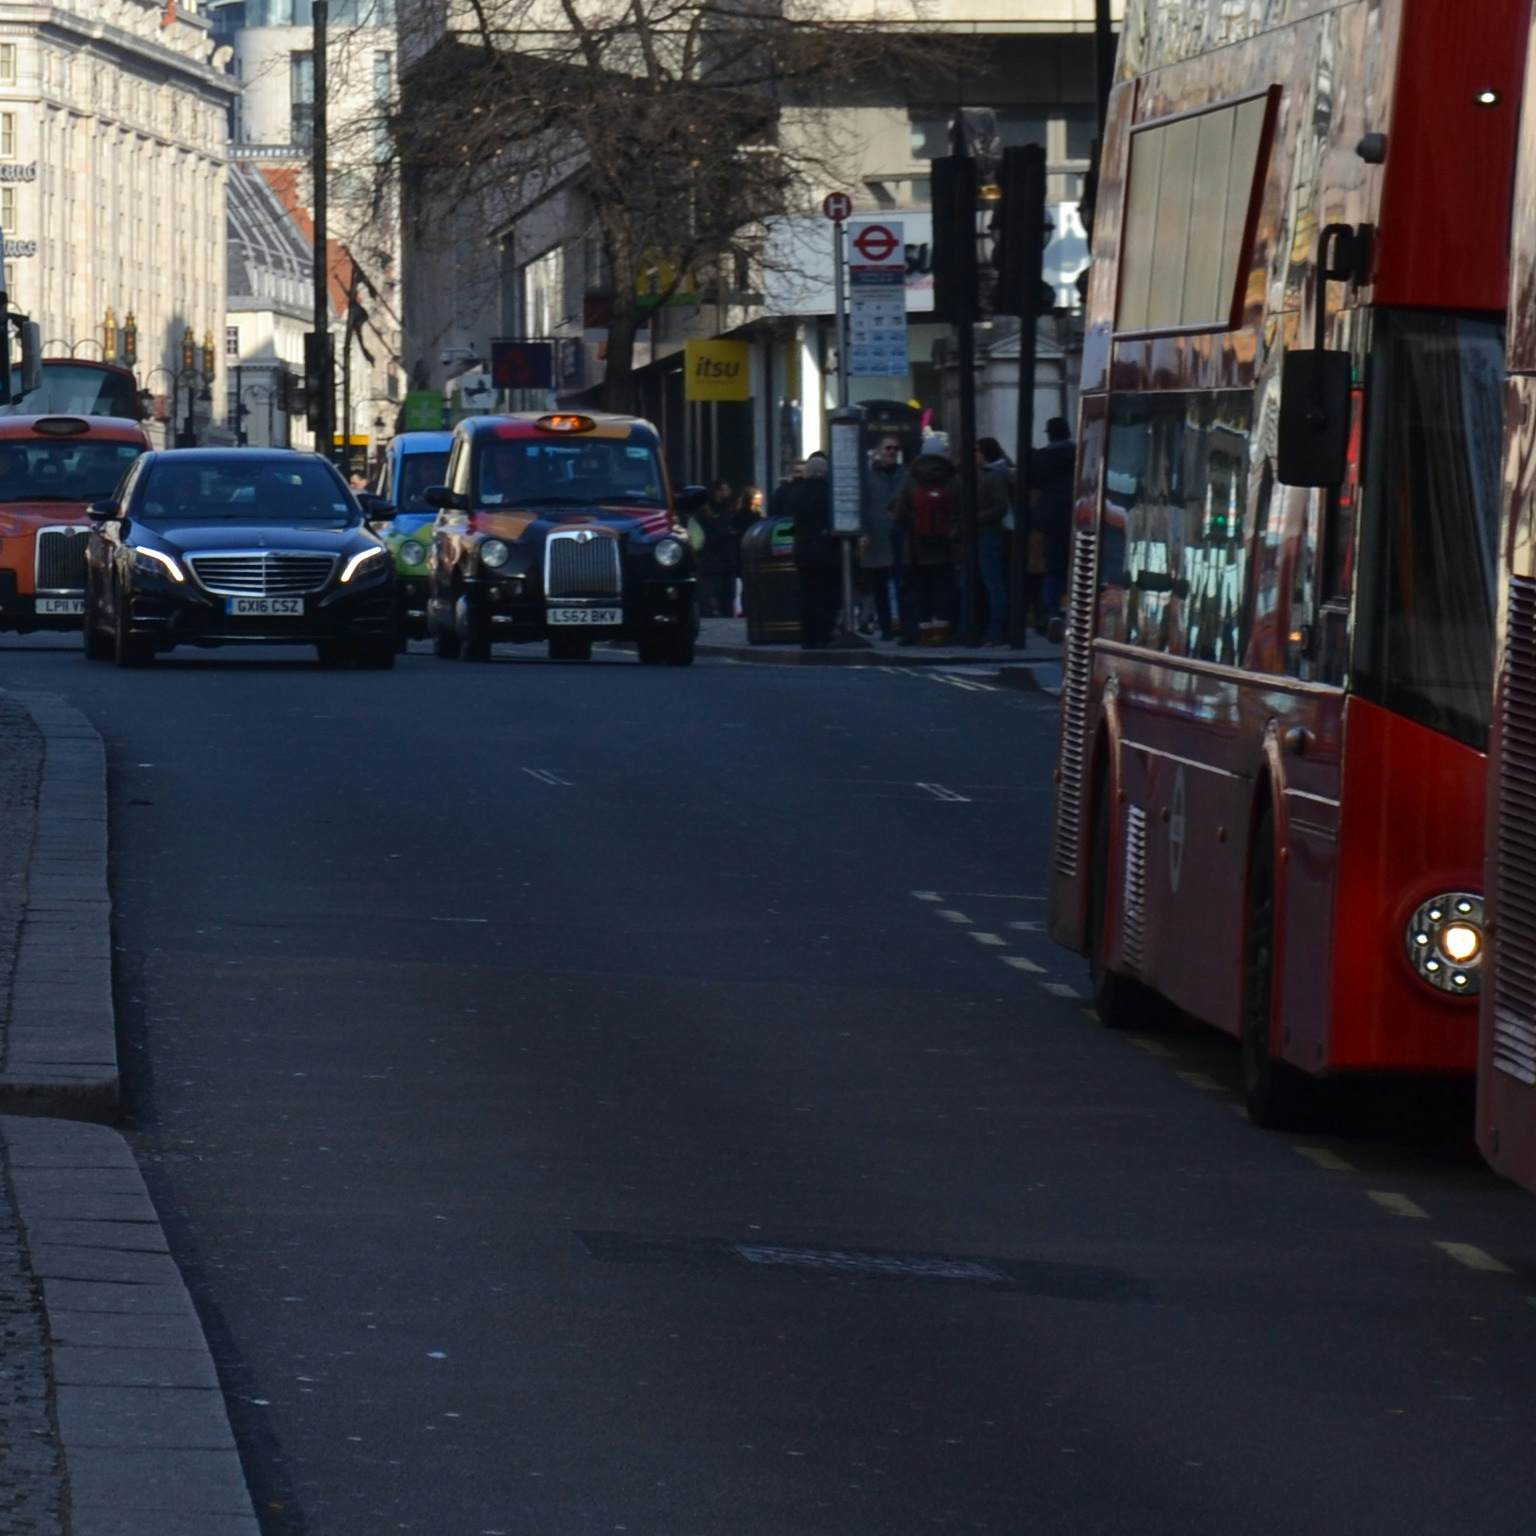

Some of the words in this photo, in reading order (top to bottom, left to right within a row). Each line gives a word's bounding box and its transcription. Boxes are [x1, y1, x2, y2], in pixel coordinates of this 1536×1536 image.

[829, 197, 848, 217] H
[695, 356, 740, 377] itsu
[237, 599, 268, 613] GX16
[271, 599, 298, 613] CSZ
